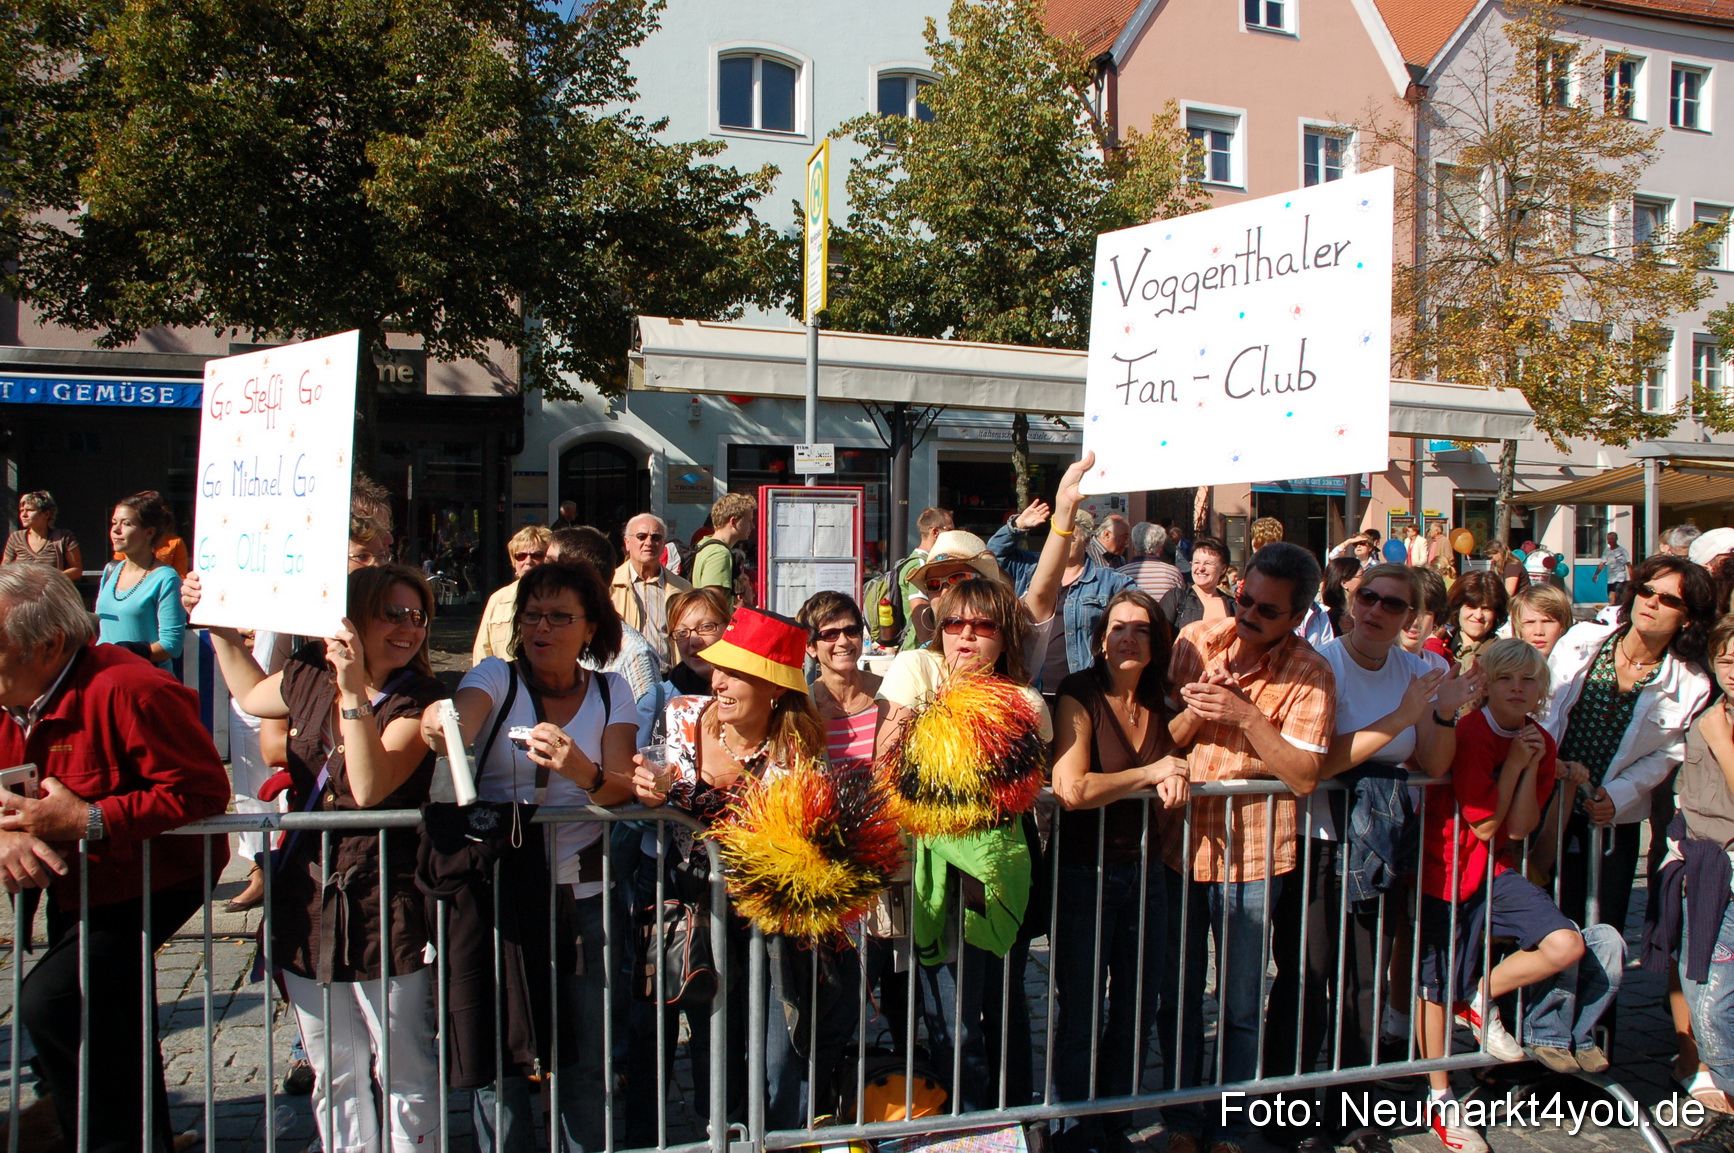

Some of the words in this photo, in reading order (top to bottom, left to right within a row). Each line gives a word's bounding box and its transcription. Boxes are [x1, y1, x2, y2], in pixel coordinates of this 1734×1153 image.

[1110, 214, 1351, 318] Voggenthaler
[53, 382, 174, 404] GEMÜSE
[1112, 349, 1177, 405] Fan
[1224, 338, 1317, 399] Club
[210, 382, 232, 421] Go
[239, 374, 283, 429] Steffi
[299, 369, 323, 405] Go
[202, 463, 222, 499] Go
[232, 455, 283, 497] Michael
[293, 453, 316, 497] Go
[198, 537, 217, 572] Go
[237, 532, 267, 573] Olli
[283, 534, 304, 575] Go
